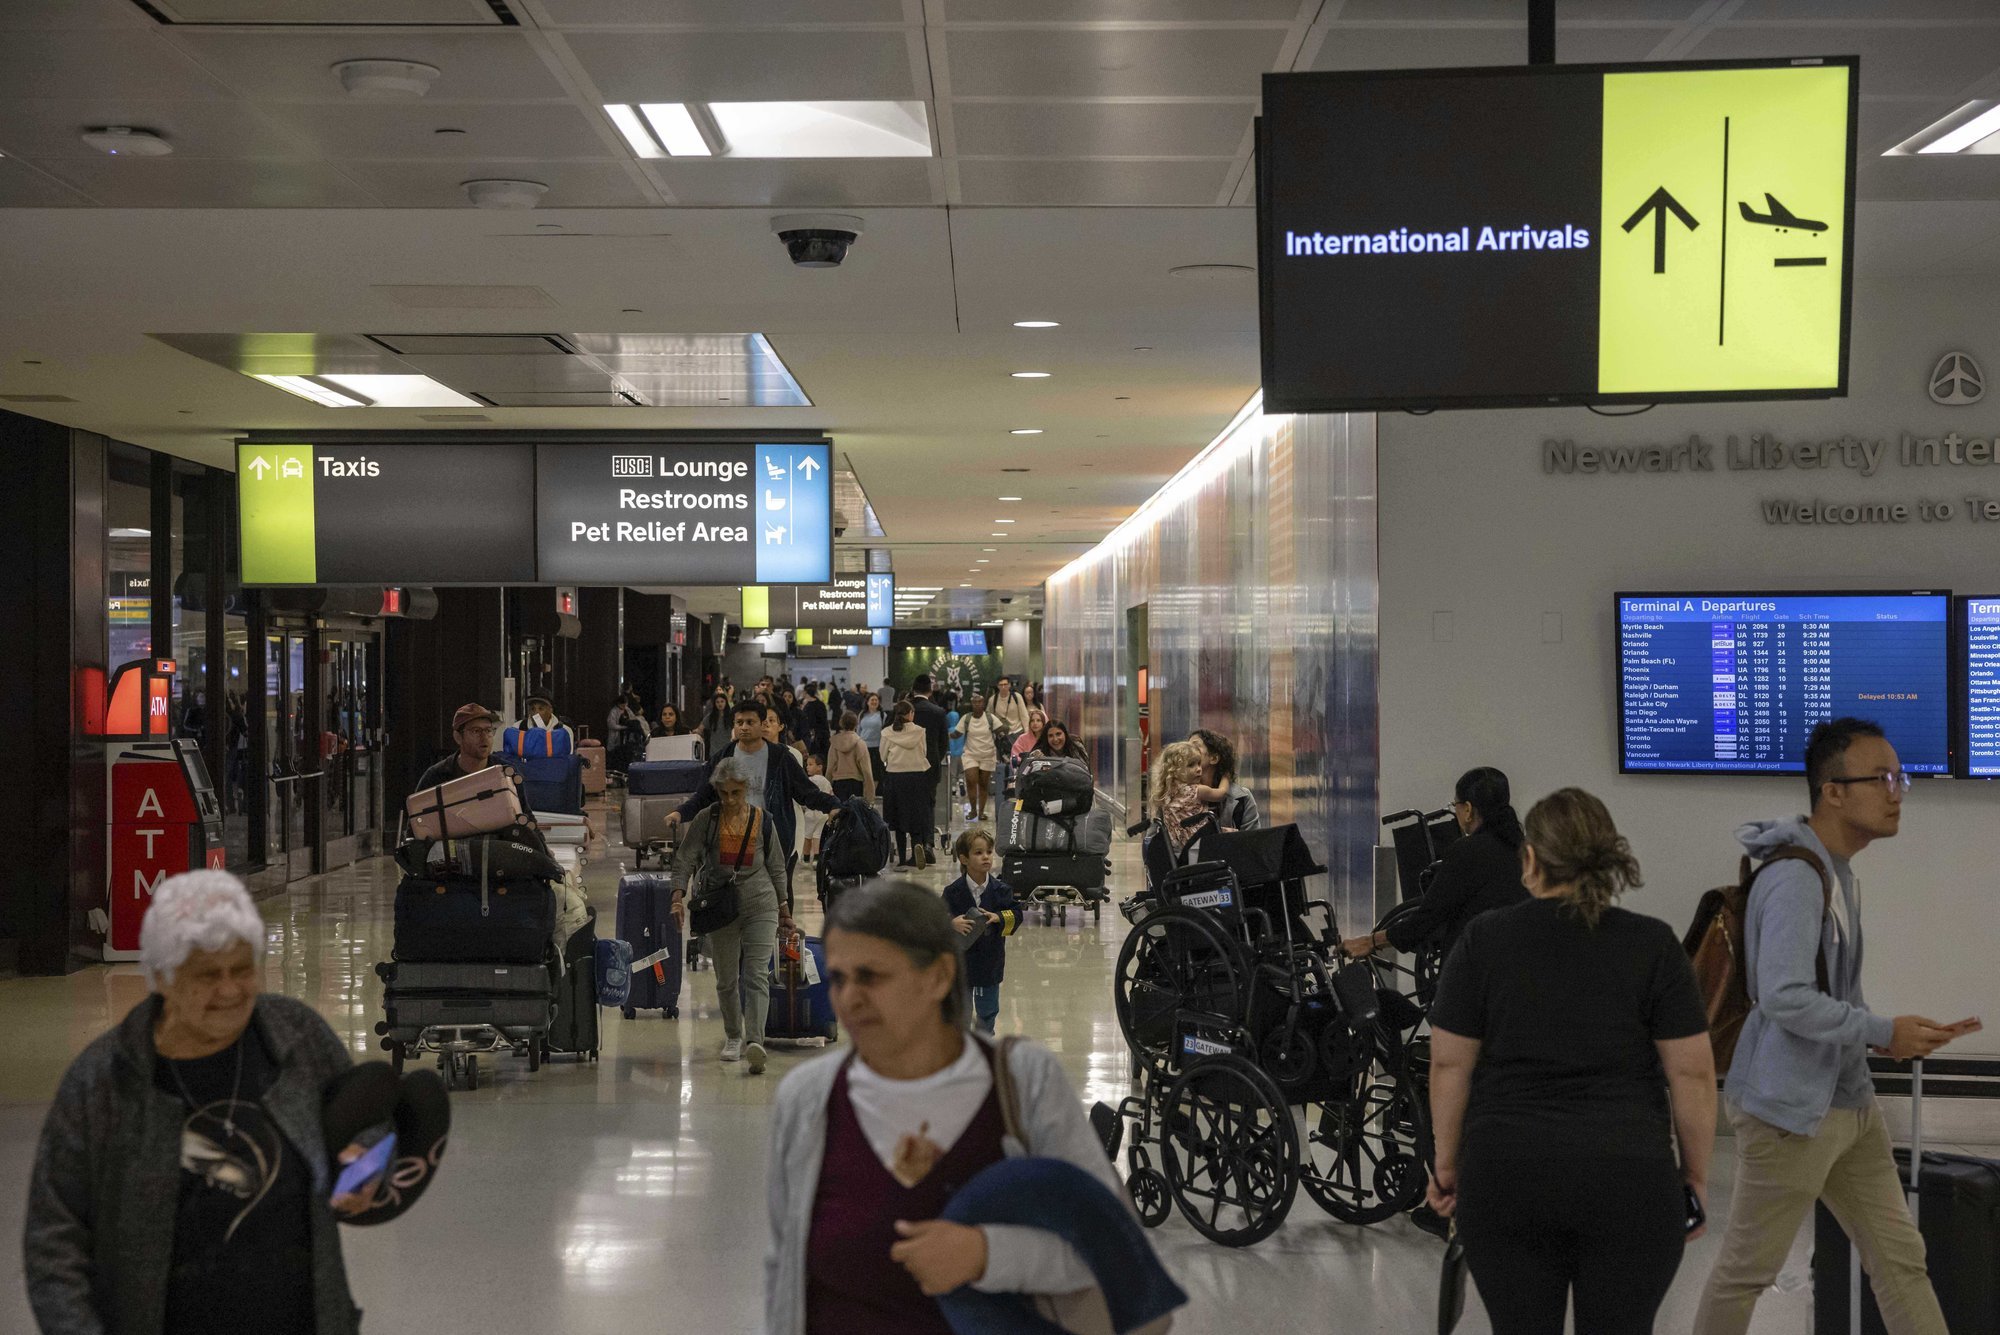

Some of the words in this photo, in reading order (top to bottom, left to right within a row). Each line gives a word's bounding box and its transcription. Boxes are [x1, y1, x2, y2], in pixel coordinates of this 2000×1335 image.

[1286, 227, 1469, 256] International
[1476, 224, 1590, 252] Arrivals
[1543, 435, 1713, 474] Newark
[1728, 431, 1885, 476] Liberty
[318, 457, 380, 478] Taxis
[620, 458, 644, 474] USO
[660, 457, 748, 482] Lounge
[620, 488, 748, 509] Restrooms
[1763, 497, 1909, 525] Welcome
[1919, 499, 1954, 521] to
[570, 522, 610, 542] Pet
[616, 522, 686, 542] Relief
[692, 522, 748, 542] Area
[834, 579, 866, 588] Lounge
[820, 590, 866, 598] Restrooms
[802, 602, 818, 610] Pet
[818, 602, 844, 610] Relief
[845, 602, 866, 610] Area
[1622, 600, 1680, 612] Terminal
[1684, 601, 1694, 612] A
[1702, 600, 1776, 614] Departures
[150, 696, 167, 716] ATM
[511, 842, 534, 854] diono
[1182, 894, 1218, 906] GATEWAY
[1220, 894, 1230, 902] 33
[1186, 1040, 1194, 1048] 23
